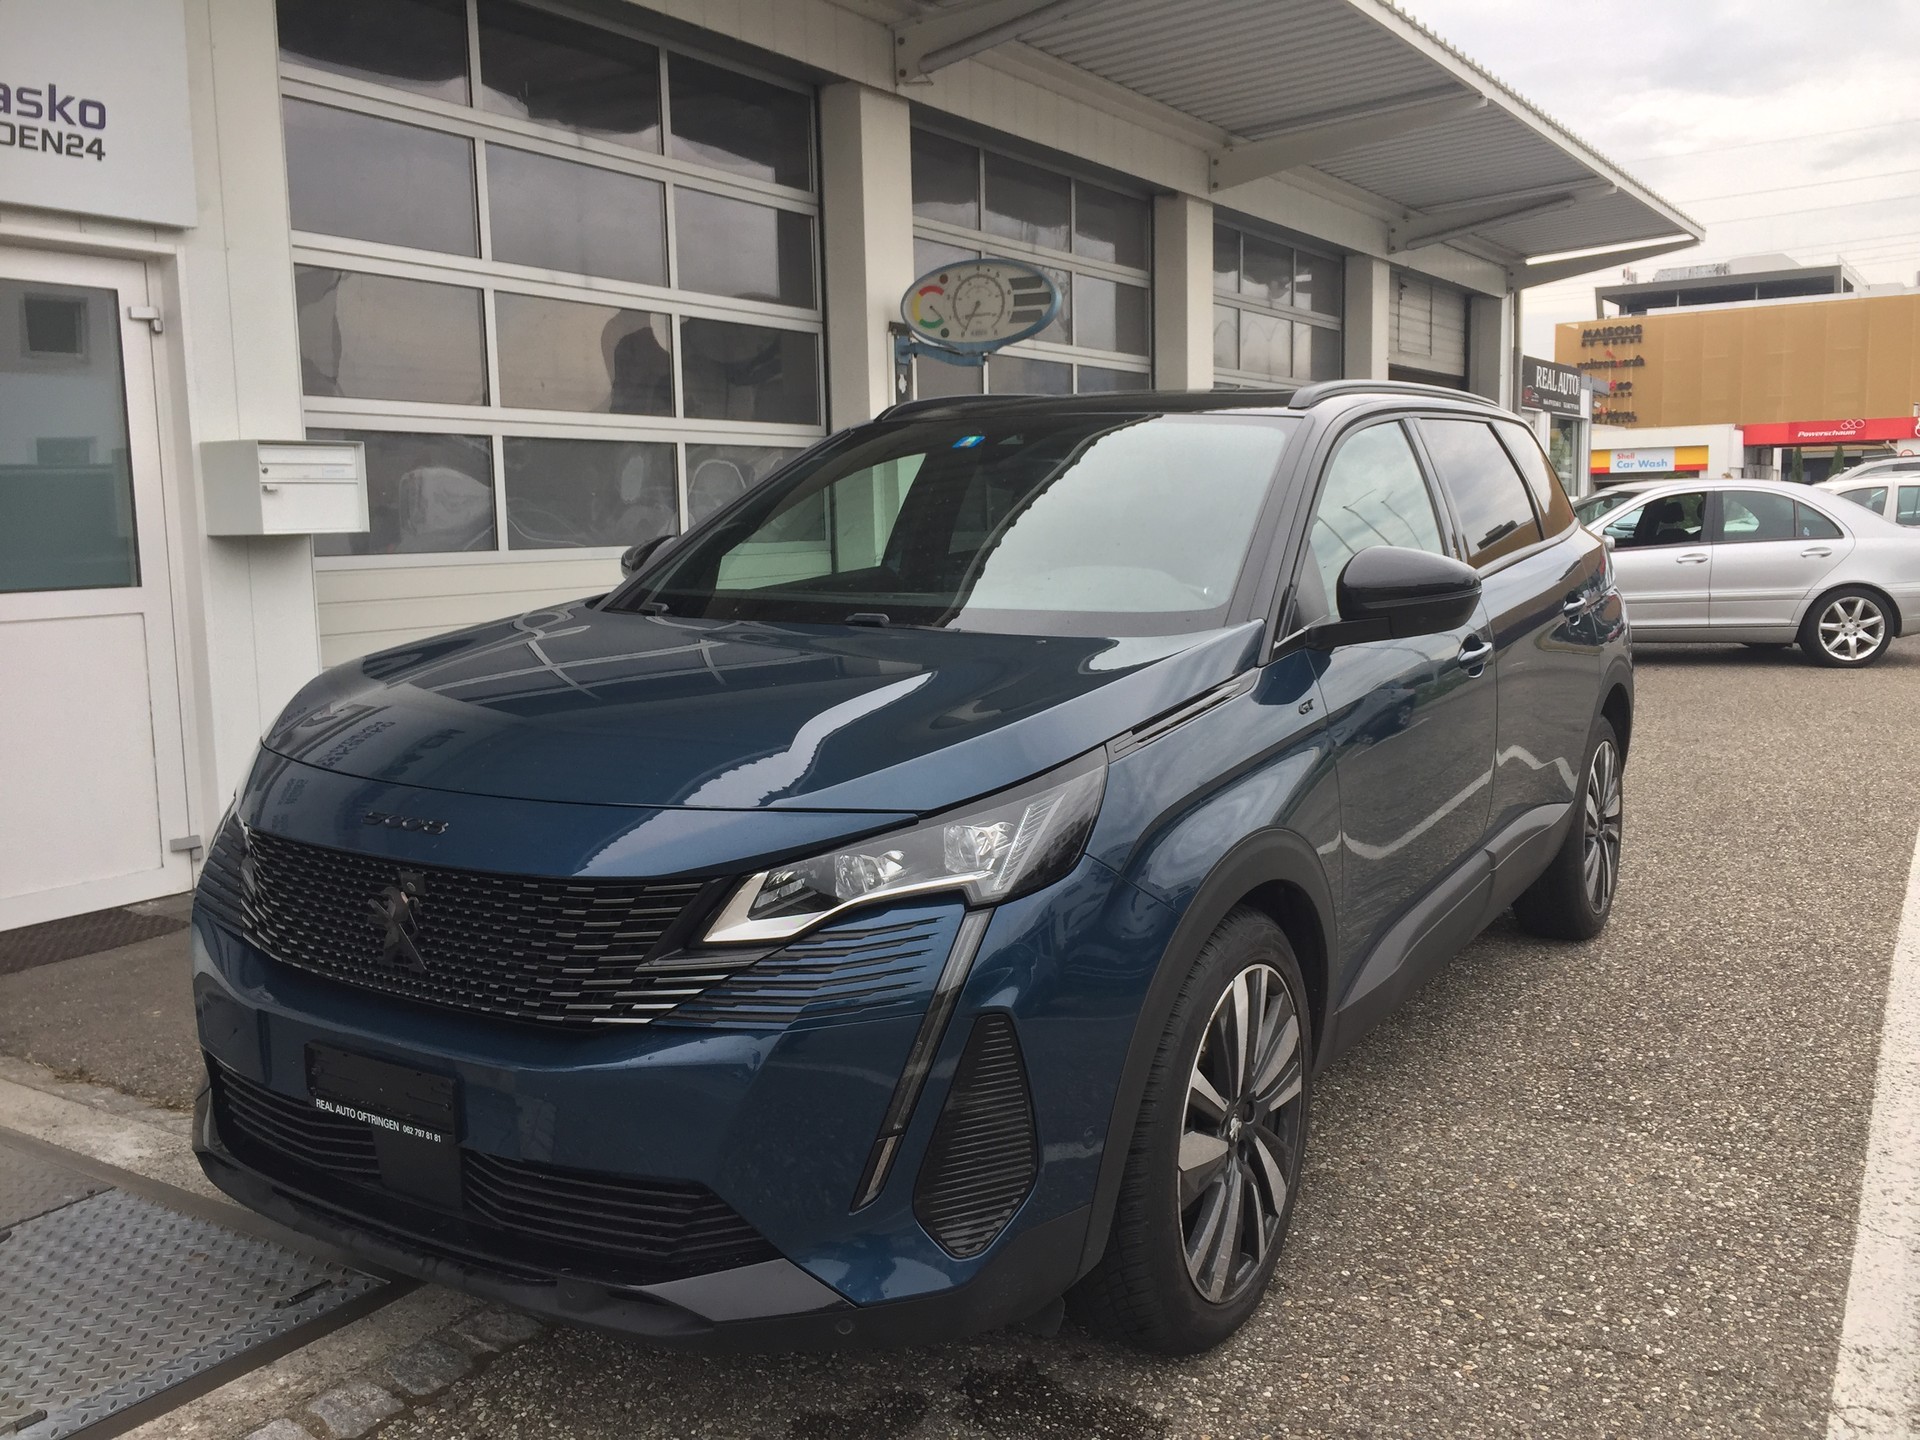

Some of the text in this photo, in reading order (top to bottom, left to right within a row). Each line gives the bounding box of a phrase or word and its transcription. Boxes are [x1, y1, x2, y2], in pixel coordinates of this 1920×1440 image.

[1582, 324, 1642, 338] MAISONS
[1536, 365, 1557, 391] REAL
[1557, 371, 1578, 396] AUTO
[1797, 429, 1856, 438] Powerschaum
[1616, 452, 1635, 460] Shell
[1616, 458, 1668, 469] Car Wash
[315, 1098, 442, 1143] REAL AUTO OFTRINGEN 062 797 81 81
